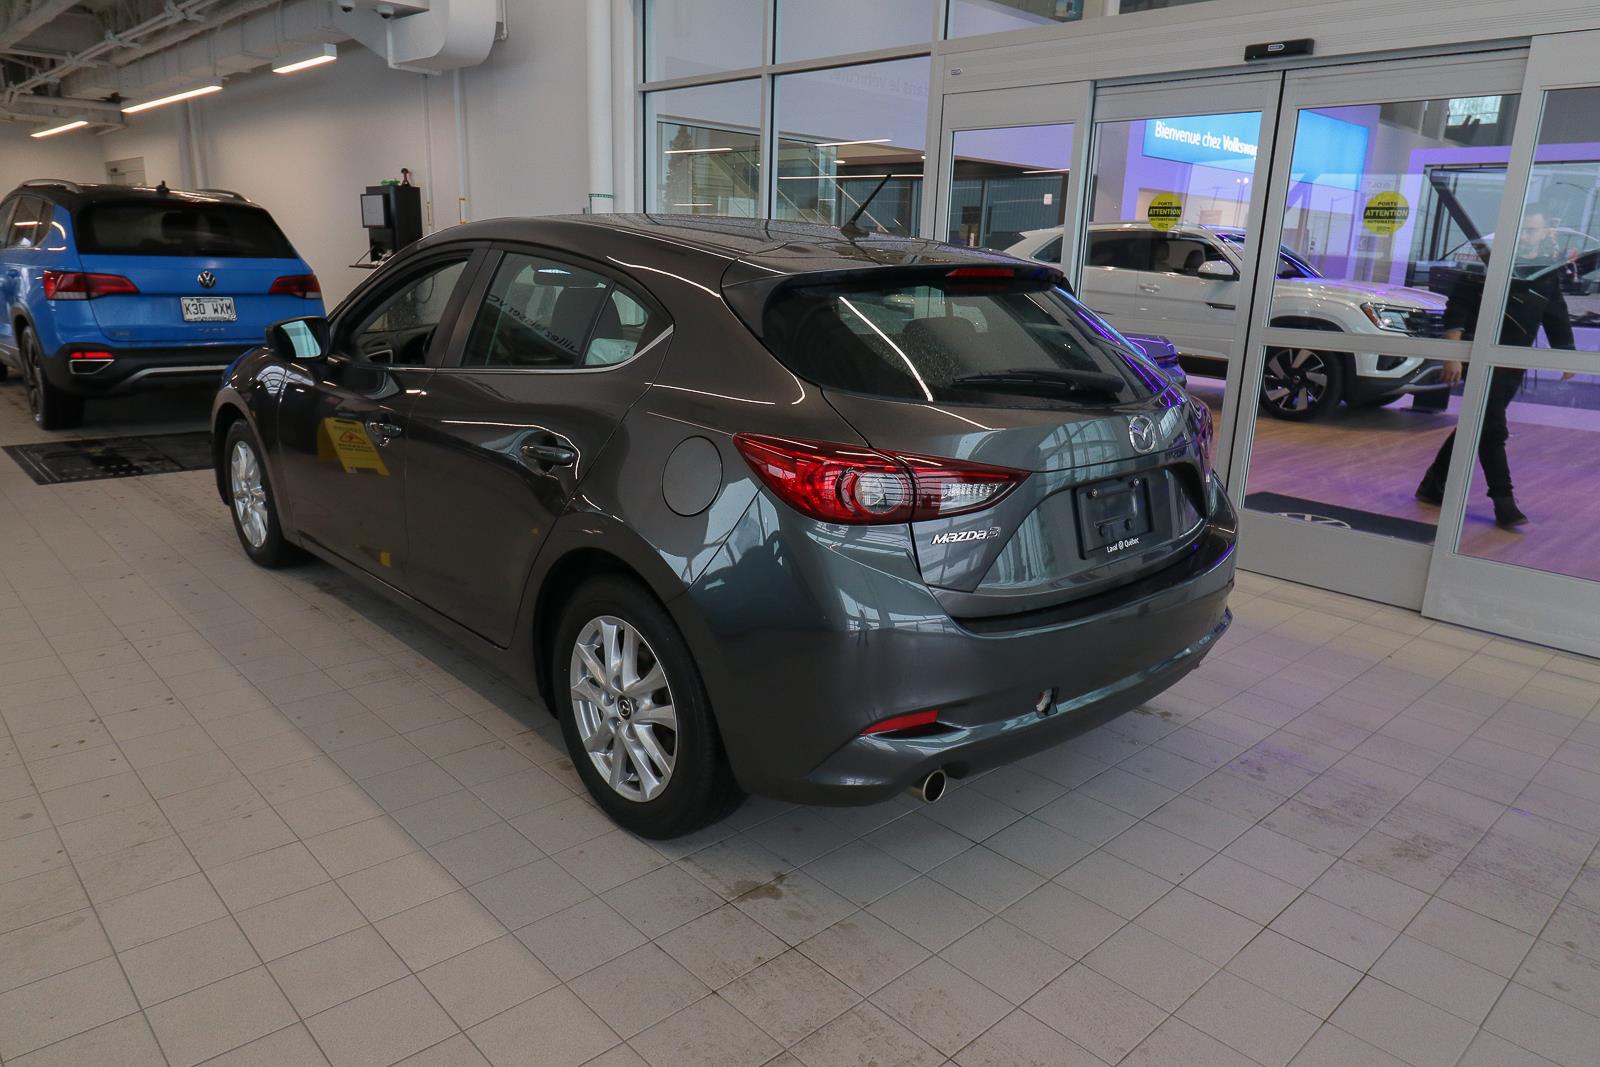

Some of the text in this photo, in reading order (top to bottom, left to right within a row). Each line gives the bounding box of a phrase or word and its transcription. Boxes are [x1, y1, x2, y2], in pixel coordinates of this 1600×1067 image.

[1154, 120, 1201, 145] Bienvenue
[1202, 131, 1222, 149] chez
[1365, 209, 1409, 217] ATTENTION
[211, 303, 233, 315] WXM
[1106, 537, 1140, 553] Laval Québec
